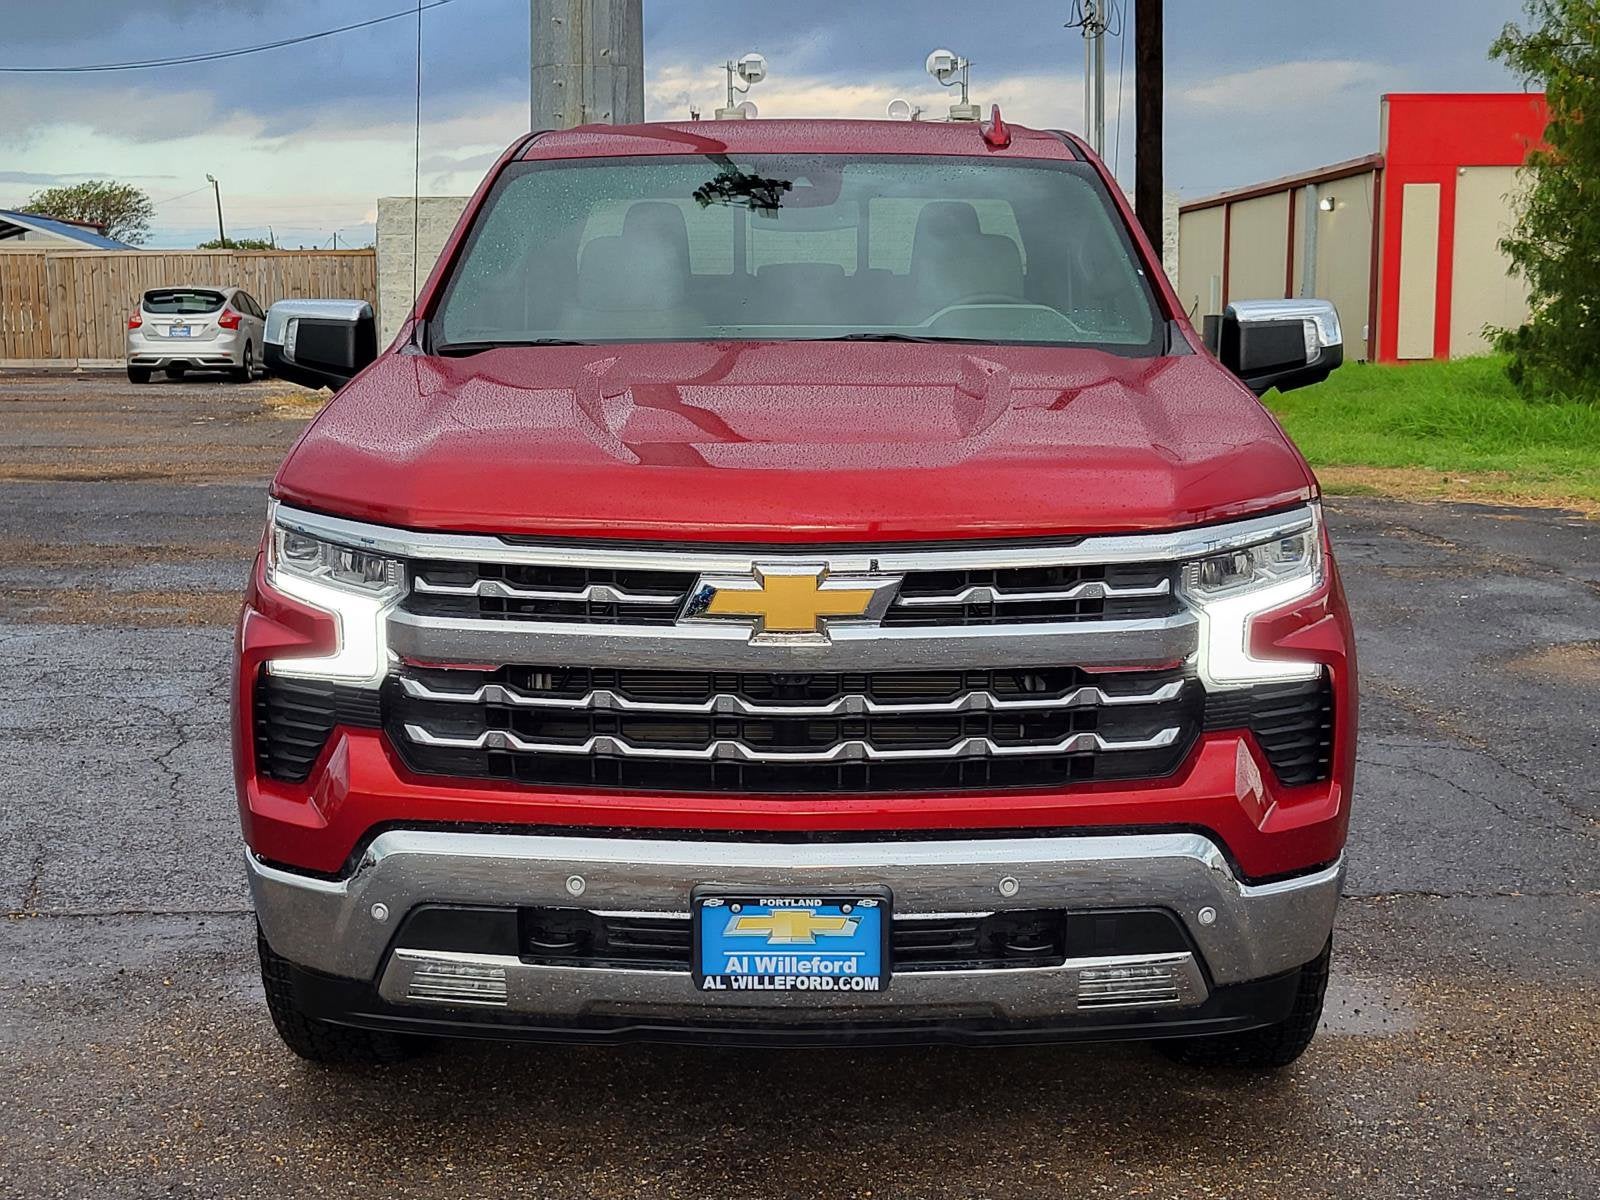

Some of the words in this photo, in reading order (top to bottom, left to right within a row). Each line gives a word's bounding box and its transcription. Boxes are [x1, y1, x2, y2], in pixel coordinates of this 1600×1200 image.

[760, 899, 822, 907] PORTLAND
[725, 957, 748, 973] Al
[754, 956, 857, 974] Willeford
[703, 976, 727, 990] AL
[731, 976, 879, 991] WILLEFORD.COM
